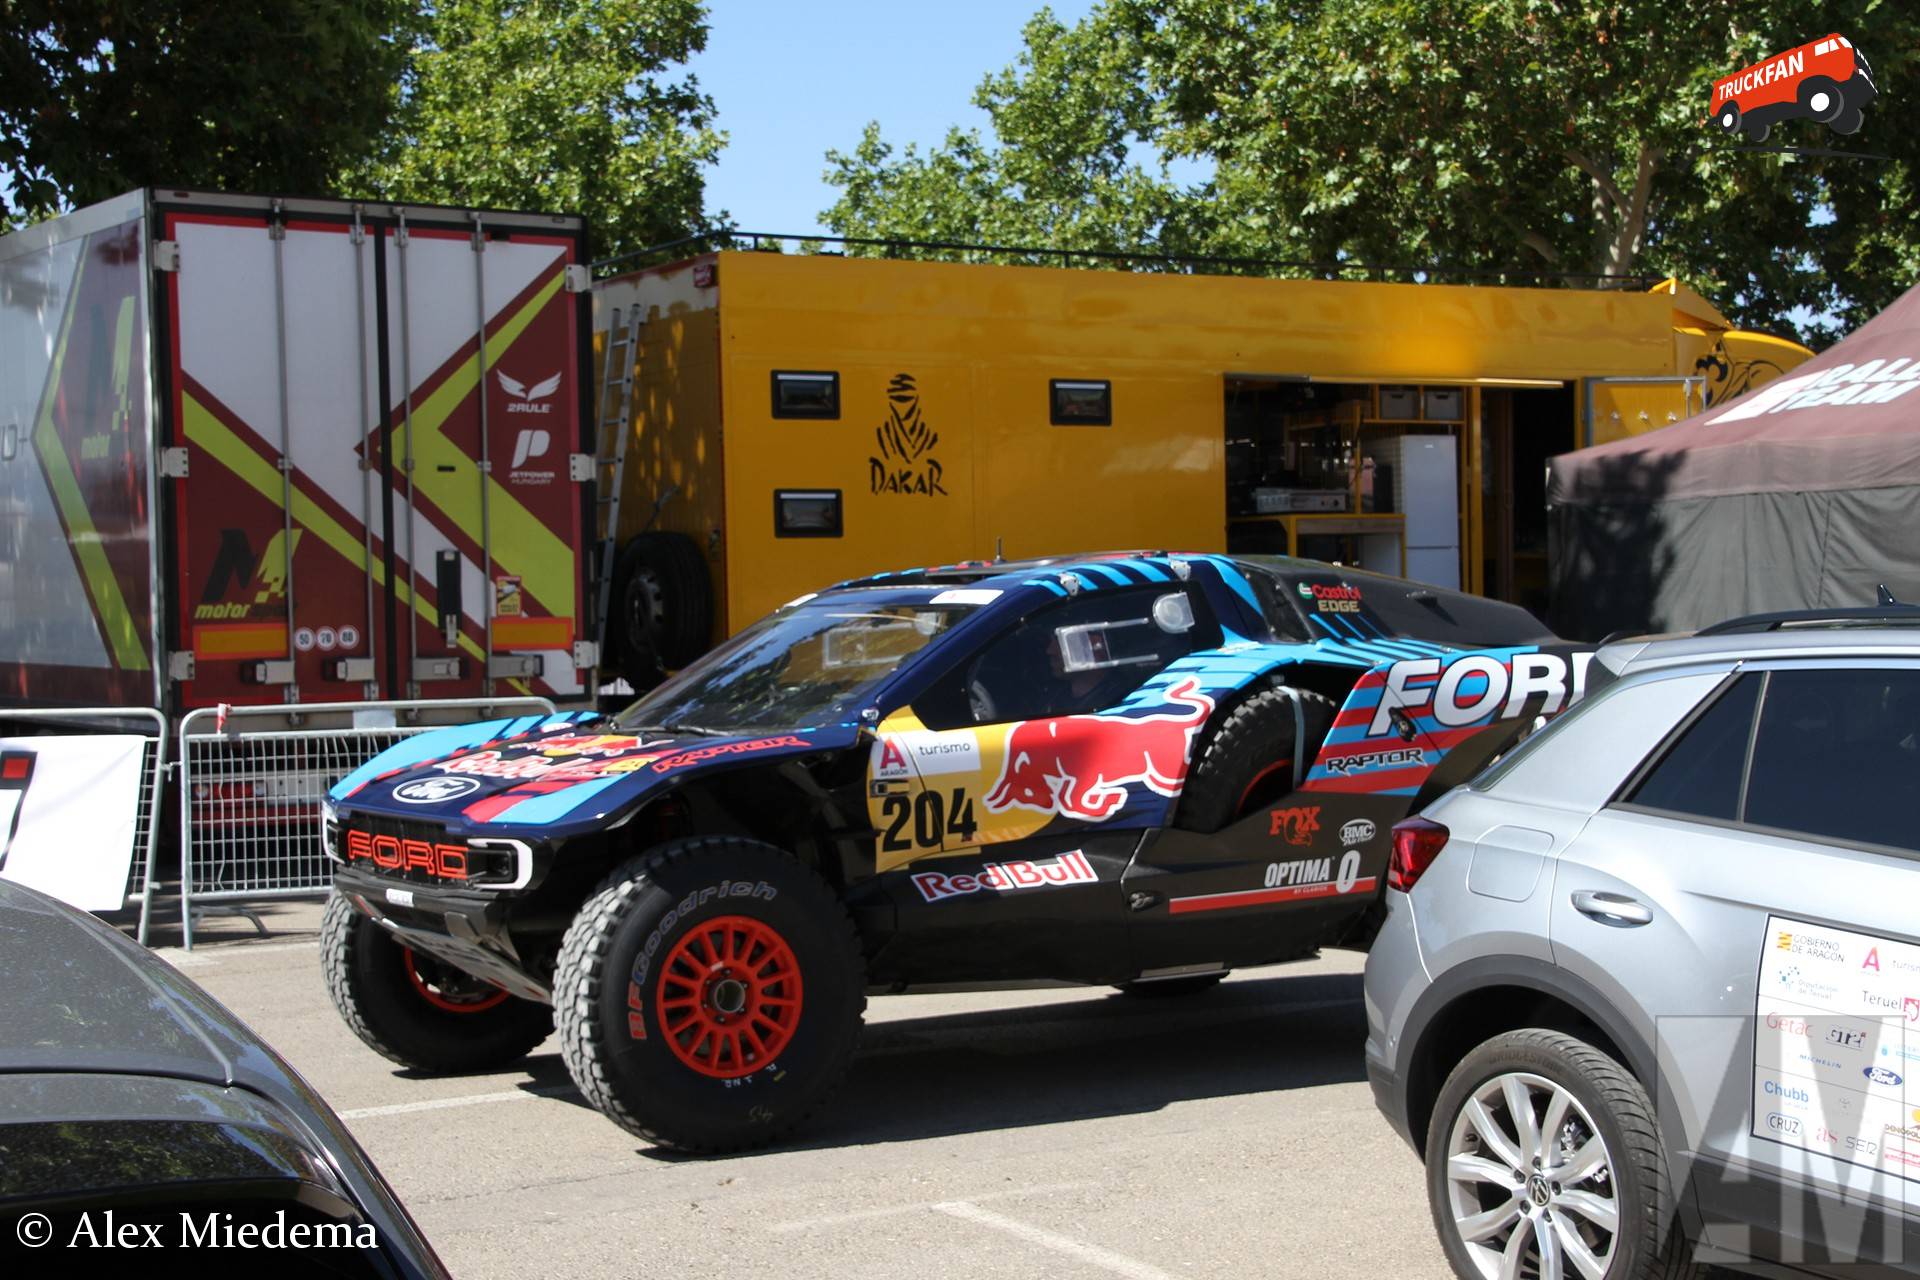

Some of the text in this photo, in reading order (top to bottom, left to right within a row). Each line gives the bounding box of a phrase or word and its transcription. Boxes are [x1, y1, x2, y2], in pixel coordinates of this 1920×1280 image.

[1800, 357, 1920, 391] RALL
[869, 457, 948, 497] DAKAR
[1312, 584, 1362, 600] Castrol
[194, 602, 252, 619] motor
[1318, 600, 1360, 612] EDGE
[652, 735, 812, 774] RAPTOR
[919, 742, 971, 757] turismo
[1326, 748, 1428, 776] RAPTOR
[882, 788, 977, 852] 204
[1269, 806, 1321, 846] FOX
[1344, 824, 1374, 838] BMC
[347, 830, 469, 880] FORD
[1264, 858, 1331, 888] OPTIMA
[1792, 944, 1804, 954] DE
[1793, 934, 1840, 952] GOBIERNO
[1862, 989, 1903, 1010] Teruel
[1869, 1066, 1897, 1086] Ford
[1764, 1080, 1809, 1103] Chubb
[1769, 1114, 1799, 1134] CRUZ
